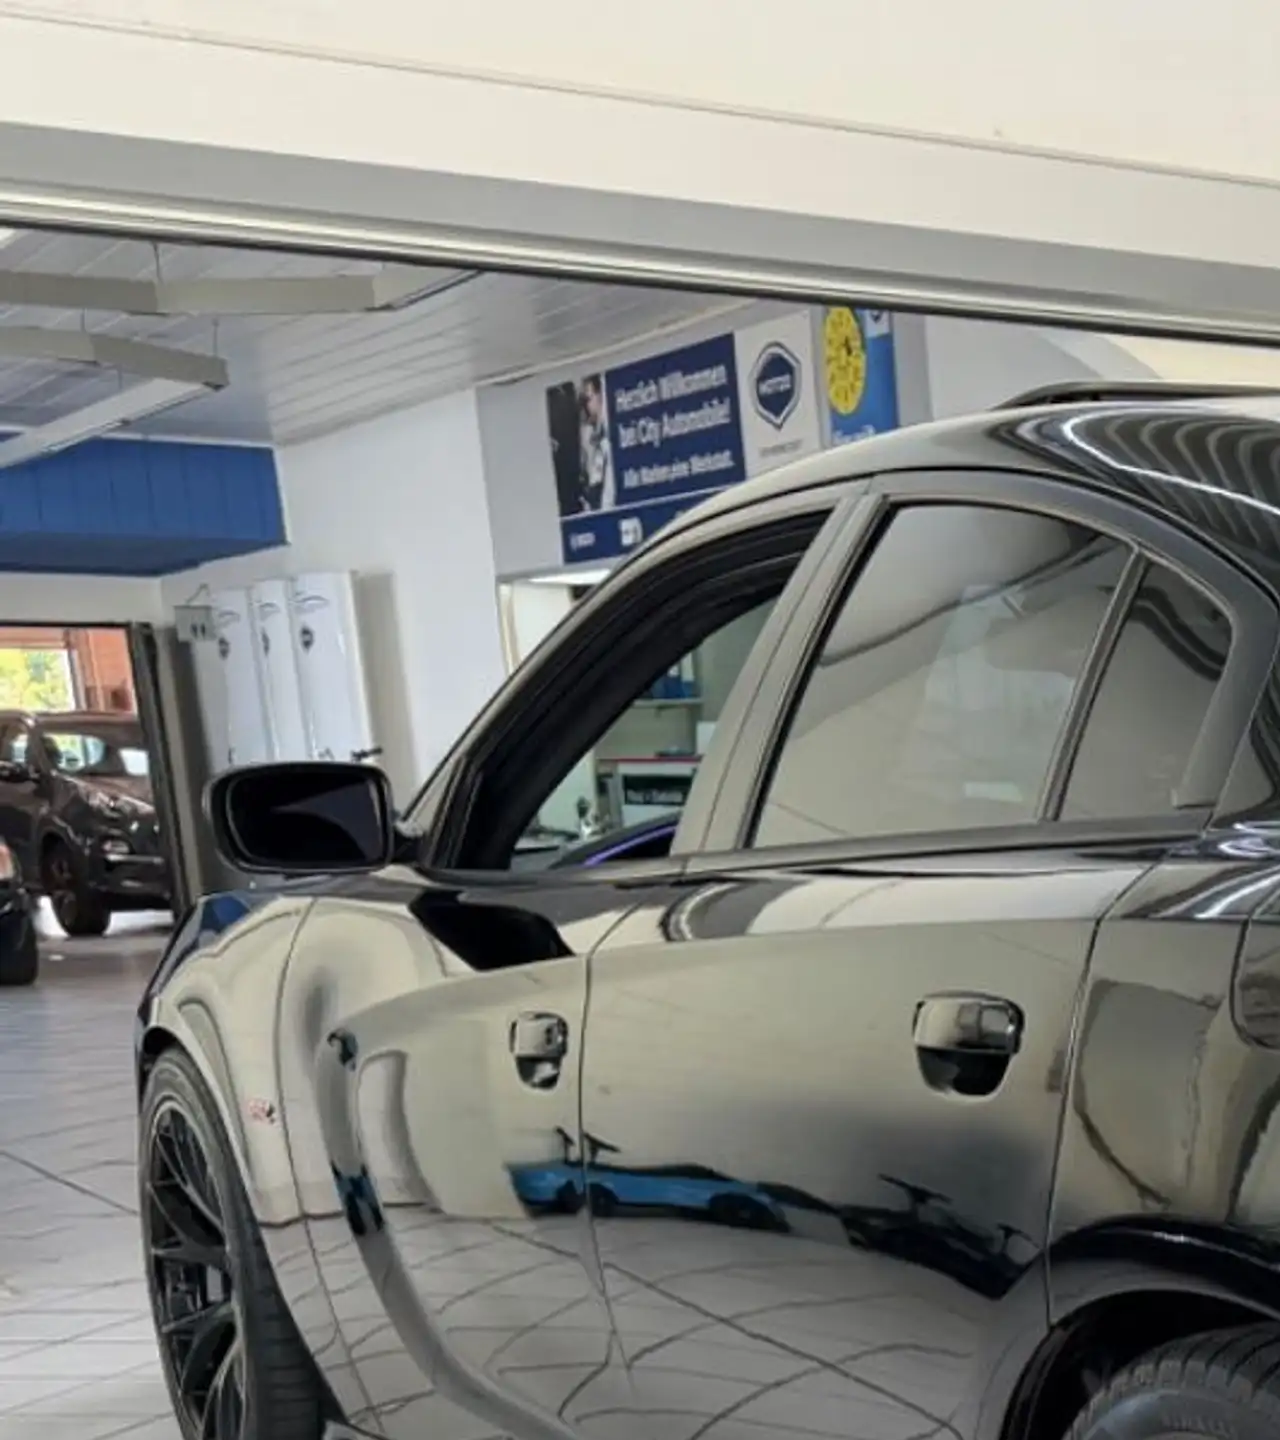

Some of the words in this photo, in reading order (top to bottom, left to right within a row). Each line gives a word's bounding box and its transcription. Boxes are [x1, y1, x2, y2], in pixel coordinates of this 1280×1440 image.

[615, 379, 658, 413] Herzlich
[659, 364, 728, 400] Willkommen
[617, 420, 638, 449] bei
[637, 416, 662, 449] City
